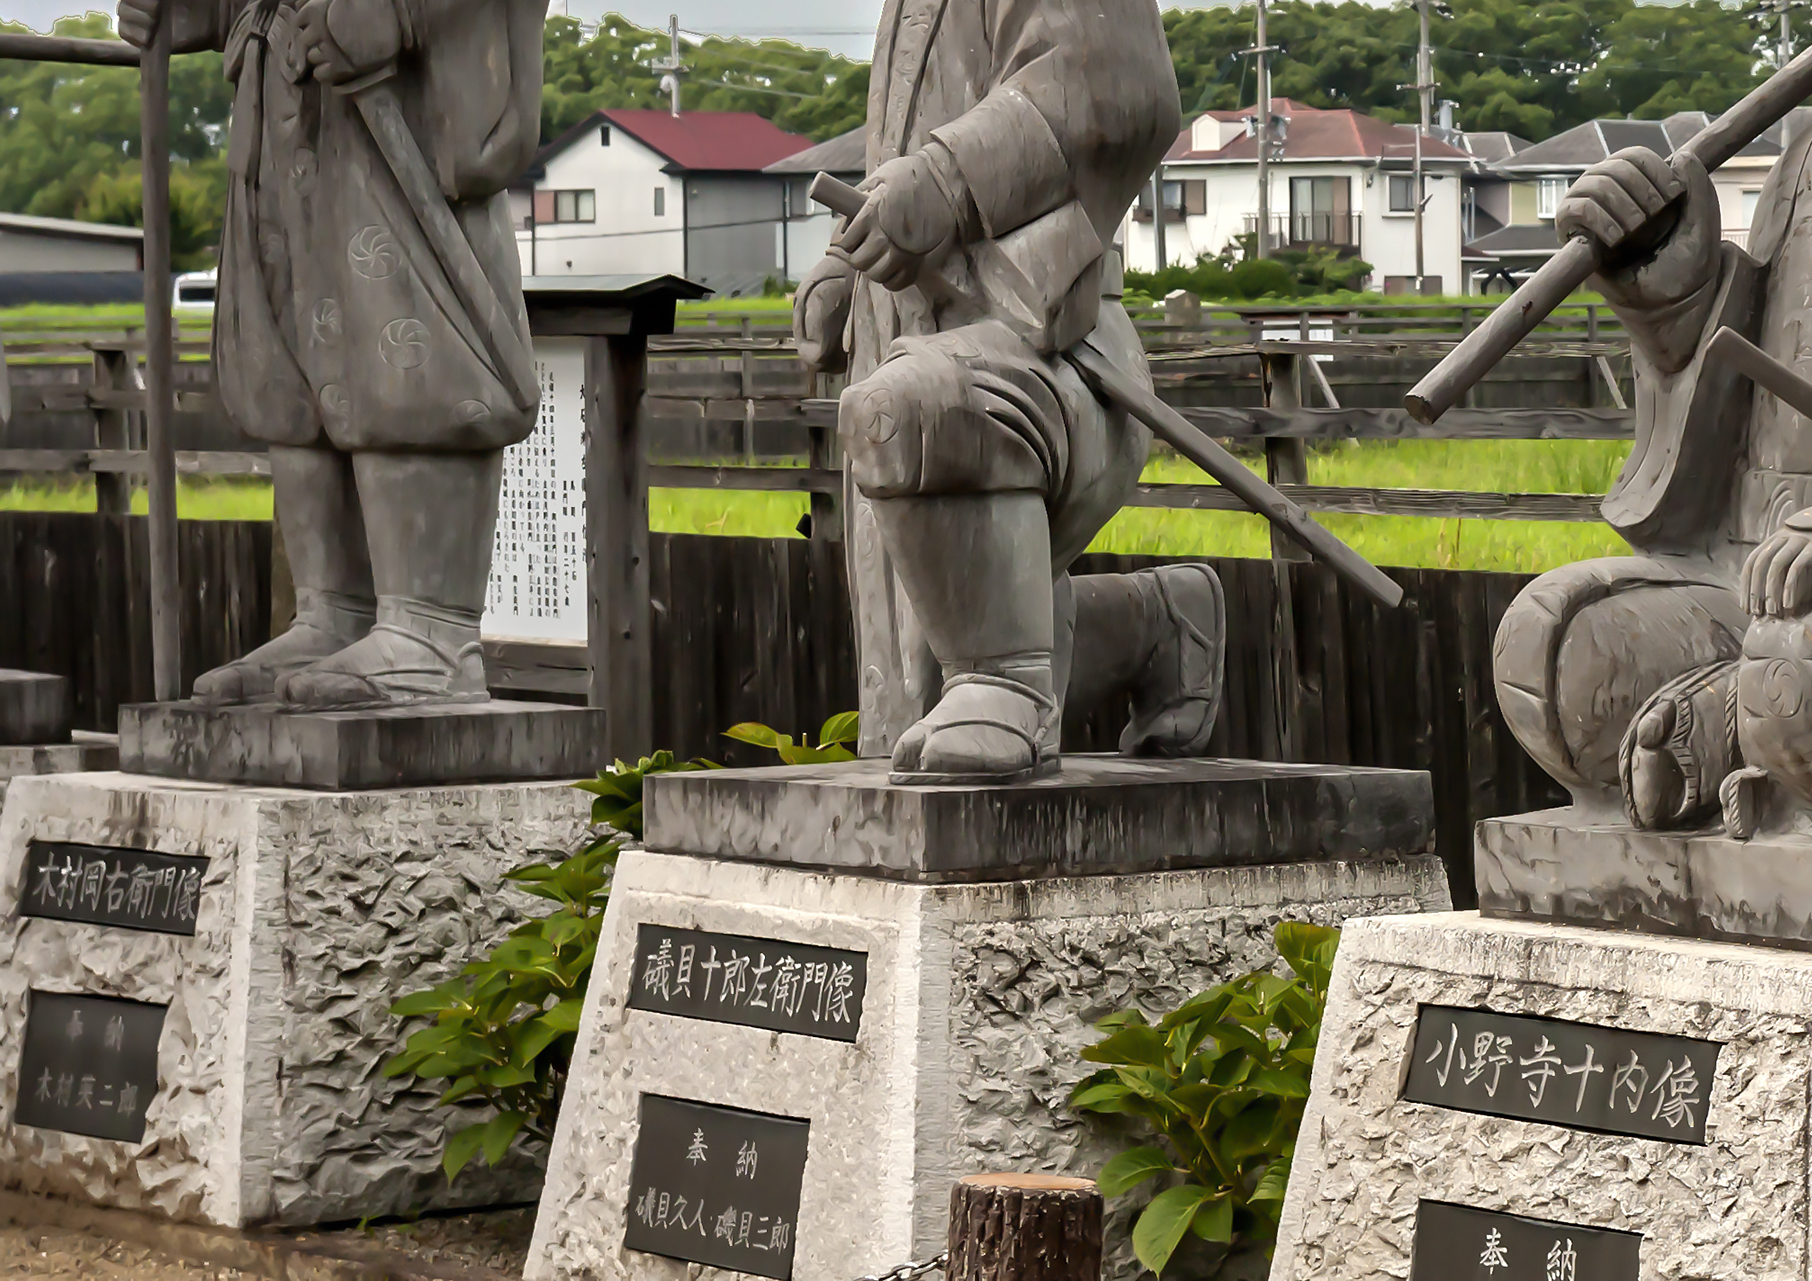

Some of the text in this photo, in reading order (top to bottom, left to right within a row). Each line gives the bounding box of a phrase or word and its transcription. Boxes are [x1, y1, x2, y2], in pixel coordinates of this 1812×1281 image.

[32, 850, 201, 921] 木村岡右衛門像
[1425, 1021, 1701, 1129] 小野寺十内像
